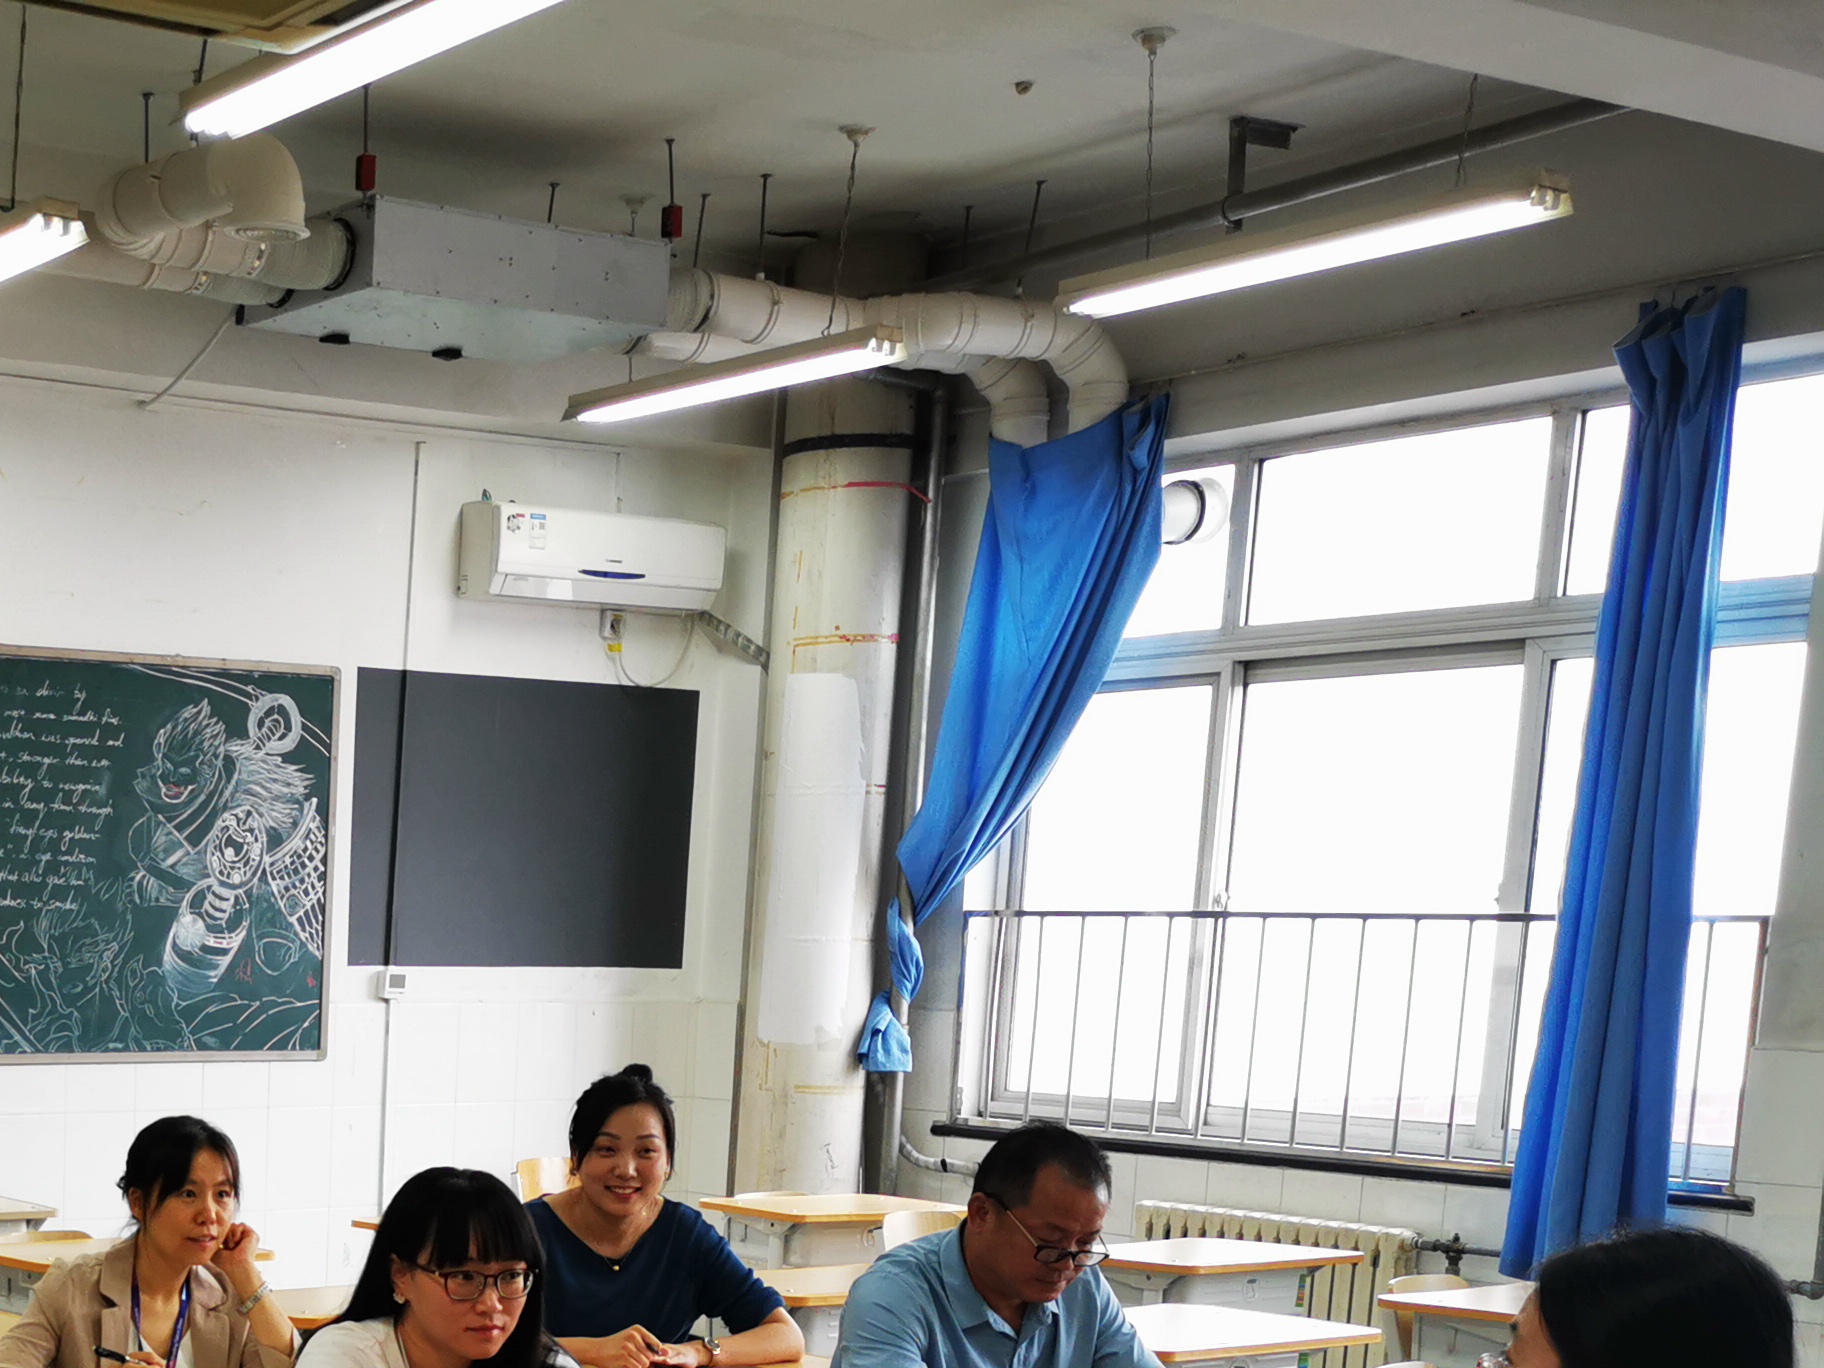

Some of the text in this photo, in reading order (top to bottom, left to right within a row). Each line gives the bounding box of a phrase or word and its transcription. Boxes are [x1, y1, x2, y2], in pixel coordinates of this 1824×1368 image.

[42, 733, 60, 744] was
[106, 732, 124, 748] and
[42, 776, 54, 788] to
[2, 796, 15, 809] in
[21, 866, 43, 884] also
